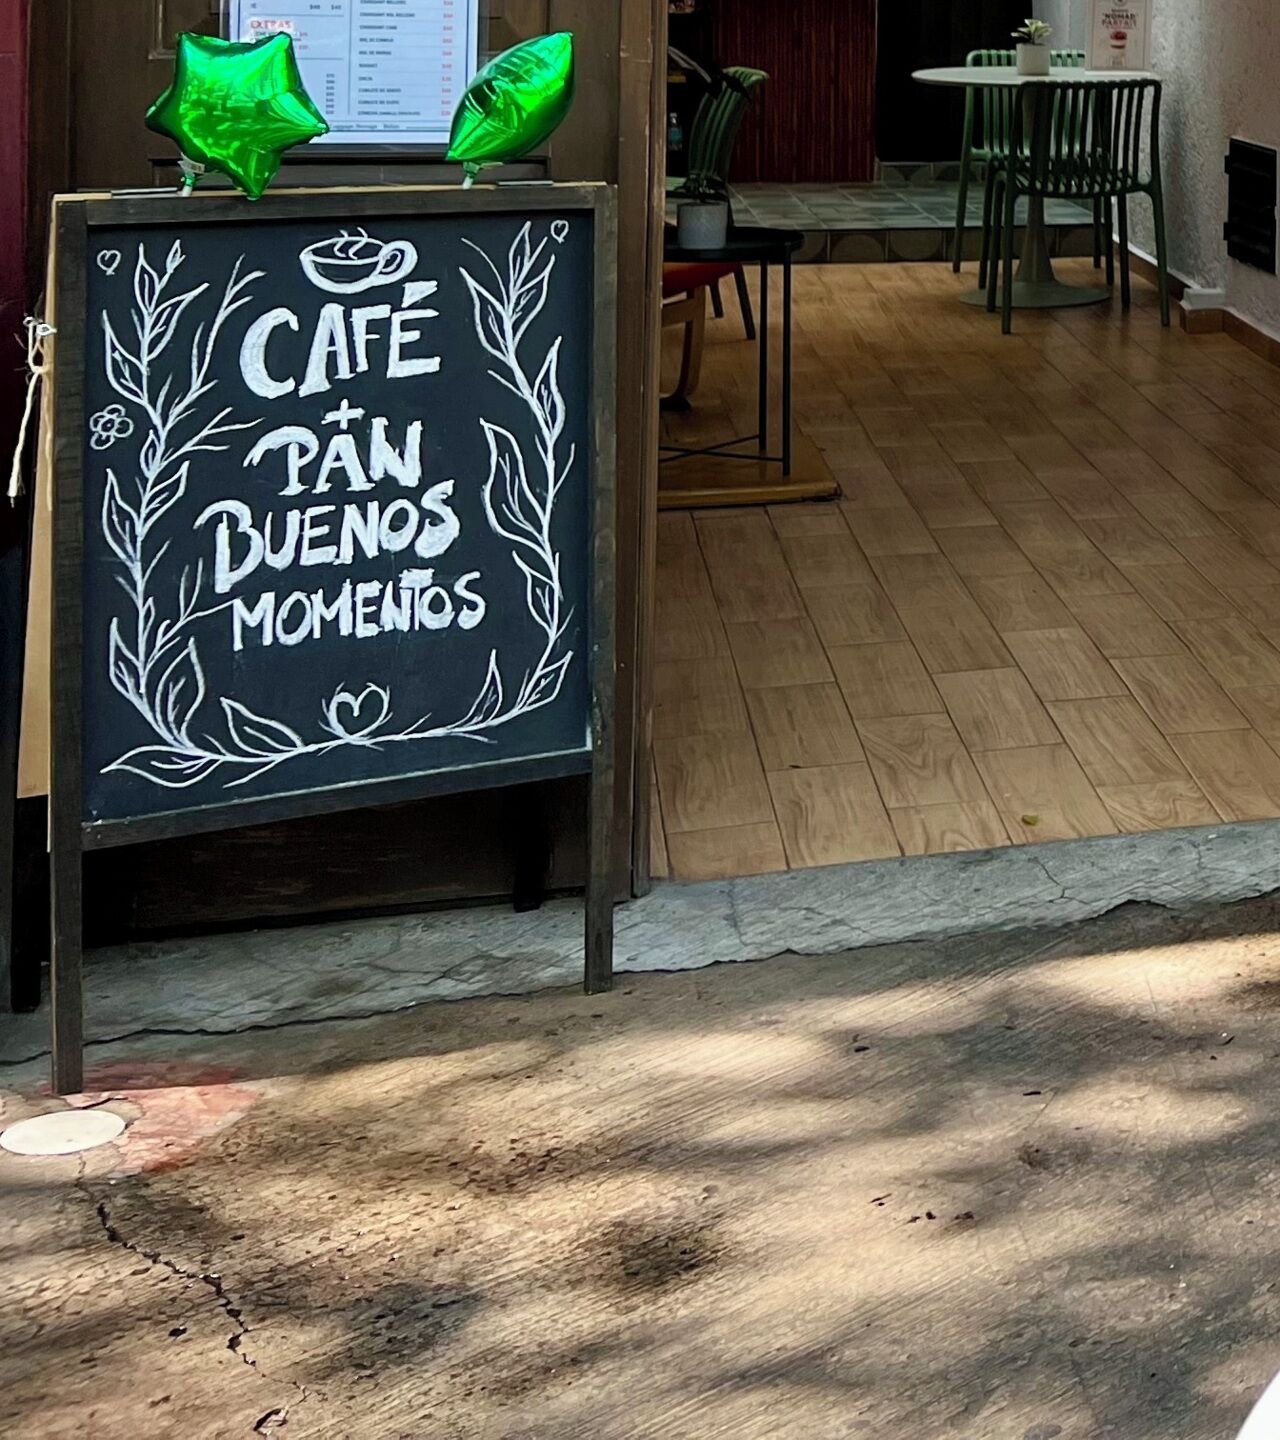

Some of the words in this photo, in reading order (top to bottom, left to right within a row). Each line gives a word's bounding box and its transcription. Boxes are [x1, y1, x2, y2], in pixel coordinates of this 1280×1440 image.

[239, 280, 441, 399] CAFÉ
[244, 416, 424, 496] PAN
[194, 480, 460, 593] BUENOS
[231, 568, 486, 651] MOMENTOS
